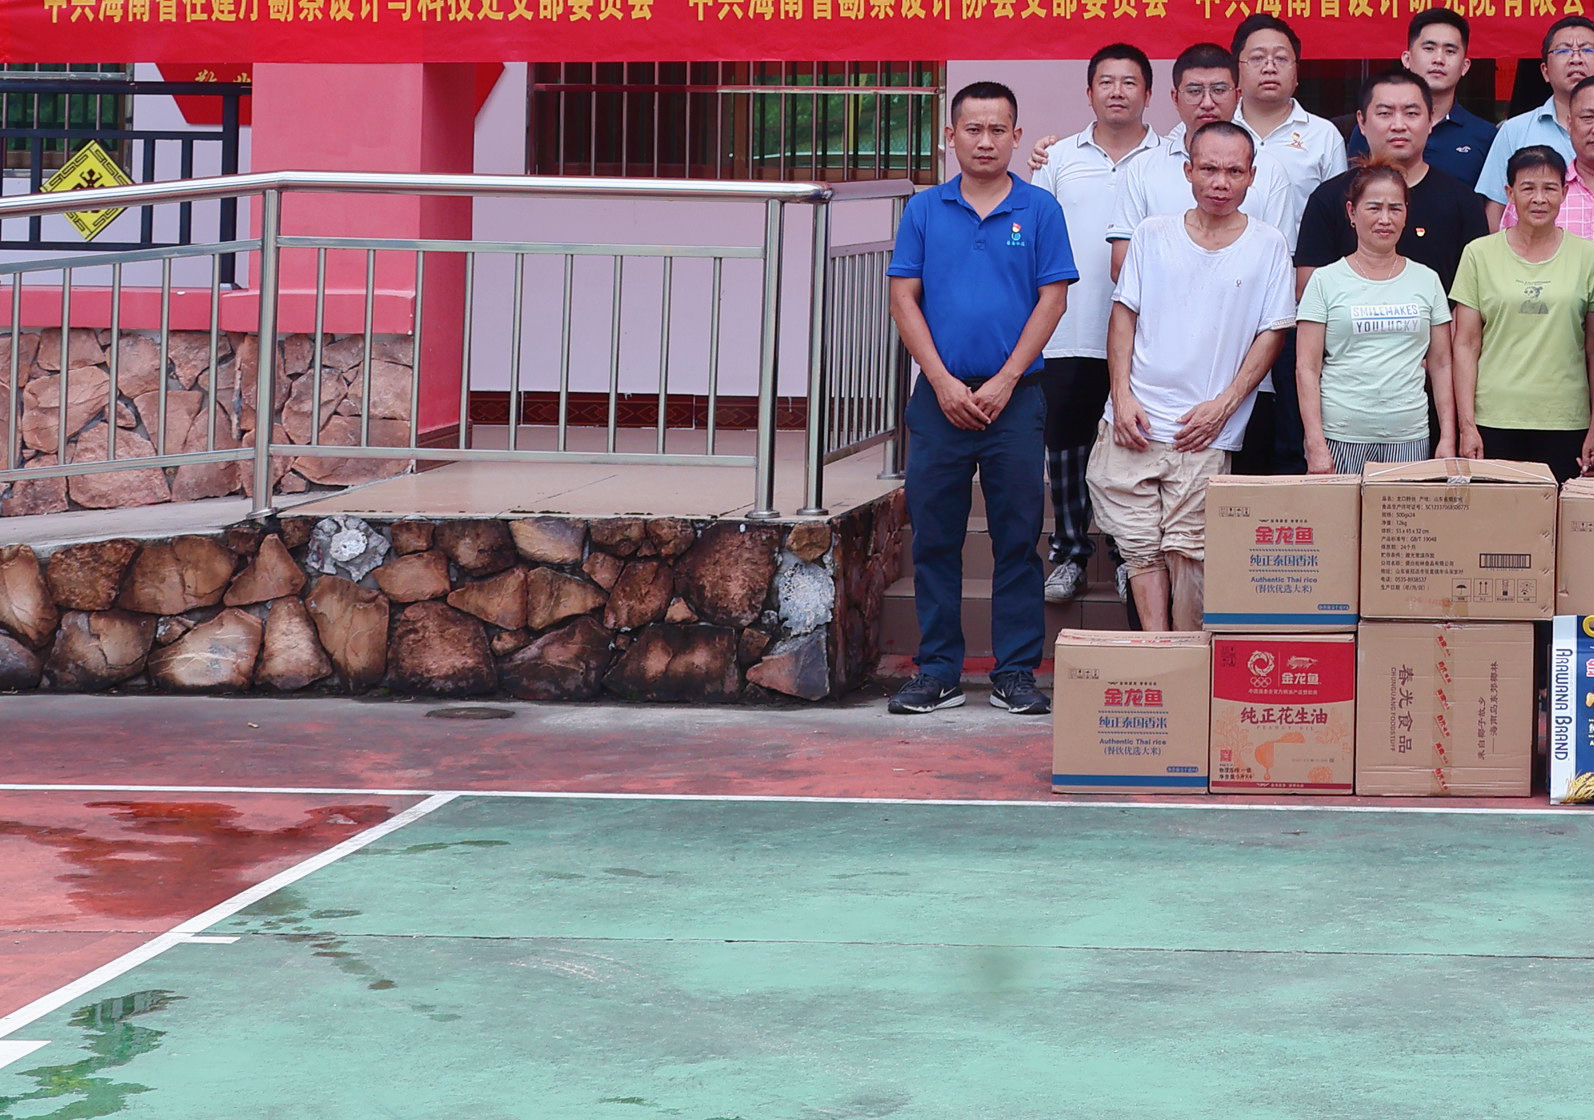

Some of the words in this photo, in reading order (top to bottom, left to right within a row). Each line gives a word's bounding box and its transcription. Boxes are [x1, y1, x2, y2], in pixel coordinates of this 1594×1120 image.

[1356, 320, 1418, 332] YOULUCKY
[1255, 526, 1313, 544] 金龙鱼
[1281, 672, 1319, 685] 金龙鱼
[1555, 649, 1573, 710] ARAWANA
[1104, 688, 1163, 707] 金龙鱼
[1240, 706, 1328, 725] 纯正花生油
[1398, 664, 1414, 753] 春光食品
[1554, 716, 1573, 760] BRAND
